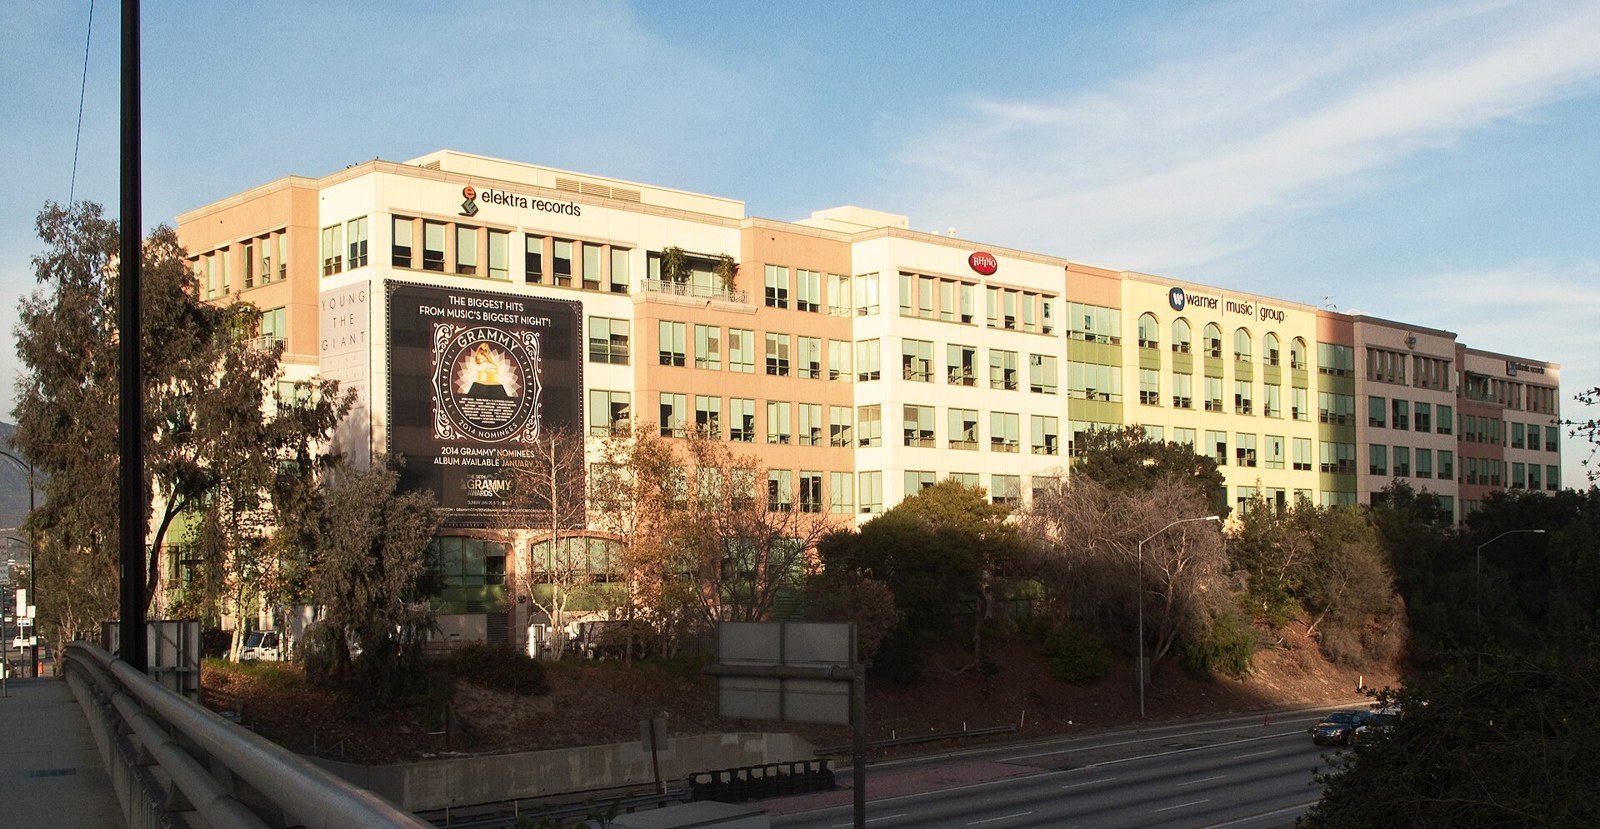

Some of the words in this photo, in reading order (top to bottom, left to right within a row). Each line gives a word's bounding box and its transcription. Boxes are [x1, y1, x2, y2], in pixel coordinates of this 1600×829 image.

[481, 189, 528, 209] elektra
[532, 199, 581, 217] records
[973, 256, 997, 269] RHINO
[321, 290, 365, 311] YOUNG
[448, 295, 466, 306] THE
[467, 297, 504, 310] BIGGEST
[505, 302, 524, 312] HITS
[1186, 293, 1219, 310] warner
[1226, 300, 1253, 316] music
[1259, 306, 1285, 324] group
[332, 313, 354, 329] THE
[419, 305, 445, 317] FROM
[446, 308, 481, 321] MUSIC'S
[482, 312, 519, 324] BIGGEST
[321, 331, 365, 351] GIANT
[457, 328, 519, 351] GRAMMY
[458, 419, 476, 435] 2014
[478, 422, 518, 439] NOMINEES
[441, 446, 459, 455] 2014
[496, 449, 535, 458] NOMINEES
[433, 456, 460, 466] ALBUM
[461, 458, 500, 467] AVAILABLE
[501, 459, 533, 468] JANUARY
[466, 479, 512, 492] GRAMMY
[467, 489, 493, 498] AWARDS
